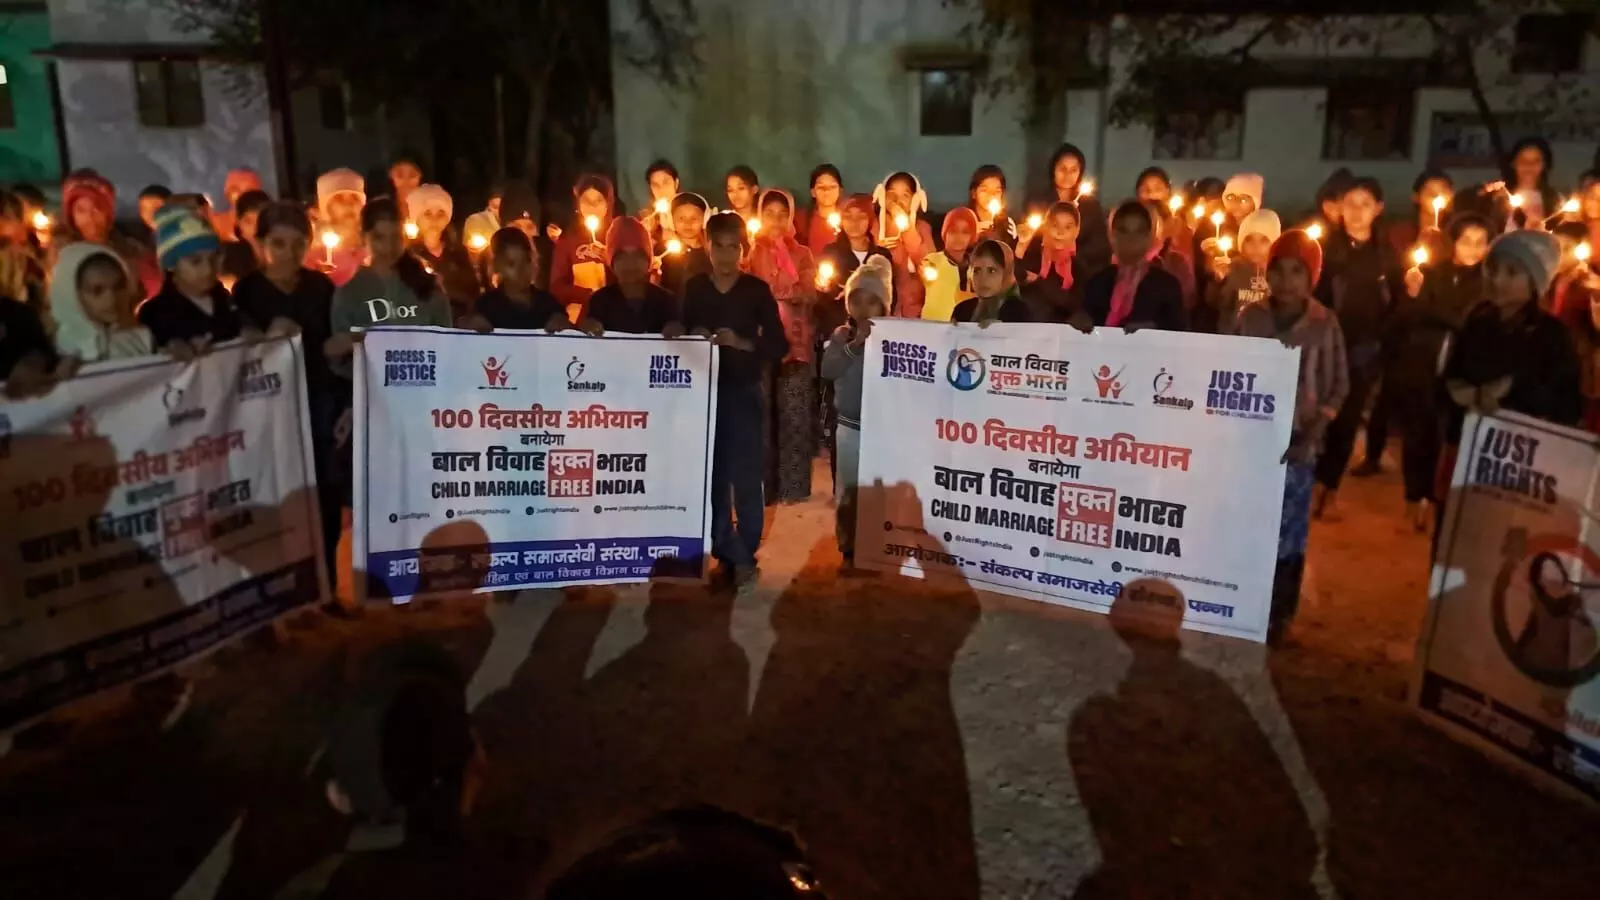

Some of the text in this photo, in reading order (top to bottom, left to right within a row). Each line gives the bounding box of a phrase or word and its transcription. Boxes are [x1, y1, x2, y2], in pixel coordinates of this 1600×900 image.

[365, 298, 418, 322] Dior
[650, 355, 680, 369] JUST
[881, 355, 936, 378] JUSTICE
[989, 353, 1070, 375] बाल विवाह
[384, 364, 436, 386] JUSTICE
[649, 369, 692, 384] RIGHTS
[989, 369, 1069, 392] मुक्त भारत
[1208, 370, 1257, 392] JUST
[568, 381, 606, 393] Sankalp
[1153, 394, 1194, 411] Sankalp
[1206, 389, 1276, 414] RIGHTS
[431, 402, 649, 430] 100 दिवसीय अभियान
[520, 430, 566, 446] बनायेगा
[935, 418, 1193, 471] 100 दिवसीय अभियान
[1481, 427, 1540, 467] JUST
[431, 445, 648, 476] बाल विवाह मुक्त भारत
[1028, 458, 1082, 480] बनायेगा
[431, 478, 646, 499] CHILD MARRIAGE FREE INDIA
[1476, 456, 1557, 504] RIGHTS
[934, 465, 1187, 529] बाल विवाह मुक्त भारत
[931, 498, 1182, 557] CHILD MARRIAGE FREE INDIA
[955, 534, 1013, 550] @JustRightsIndia
[523, 543, 595, 566] समाजसेवी
[980, 558, 1034, 581] संकल्प
[1037, 571, 1124, 599] समाजसेवी
[1188, 599, 1235, 618] पन्ना
